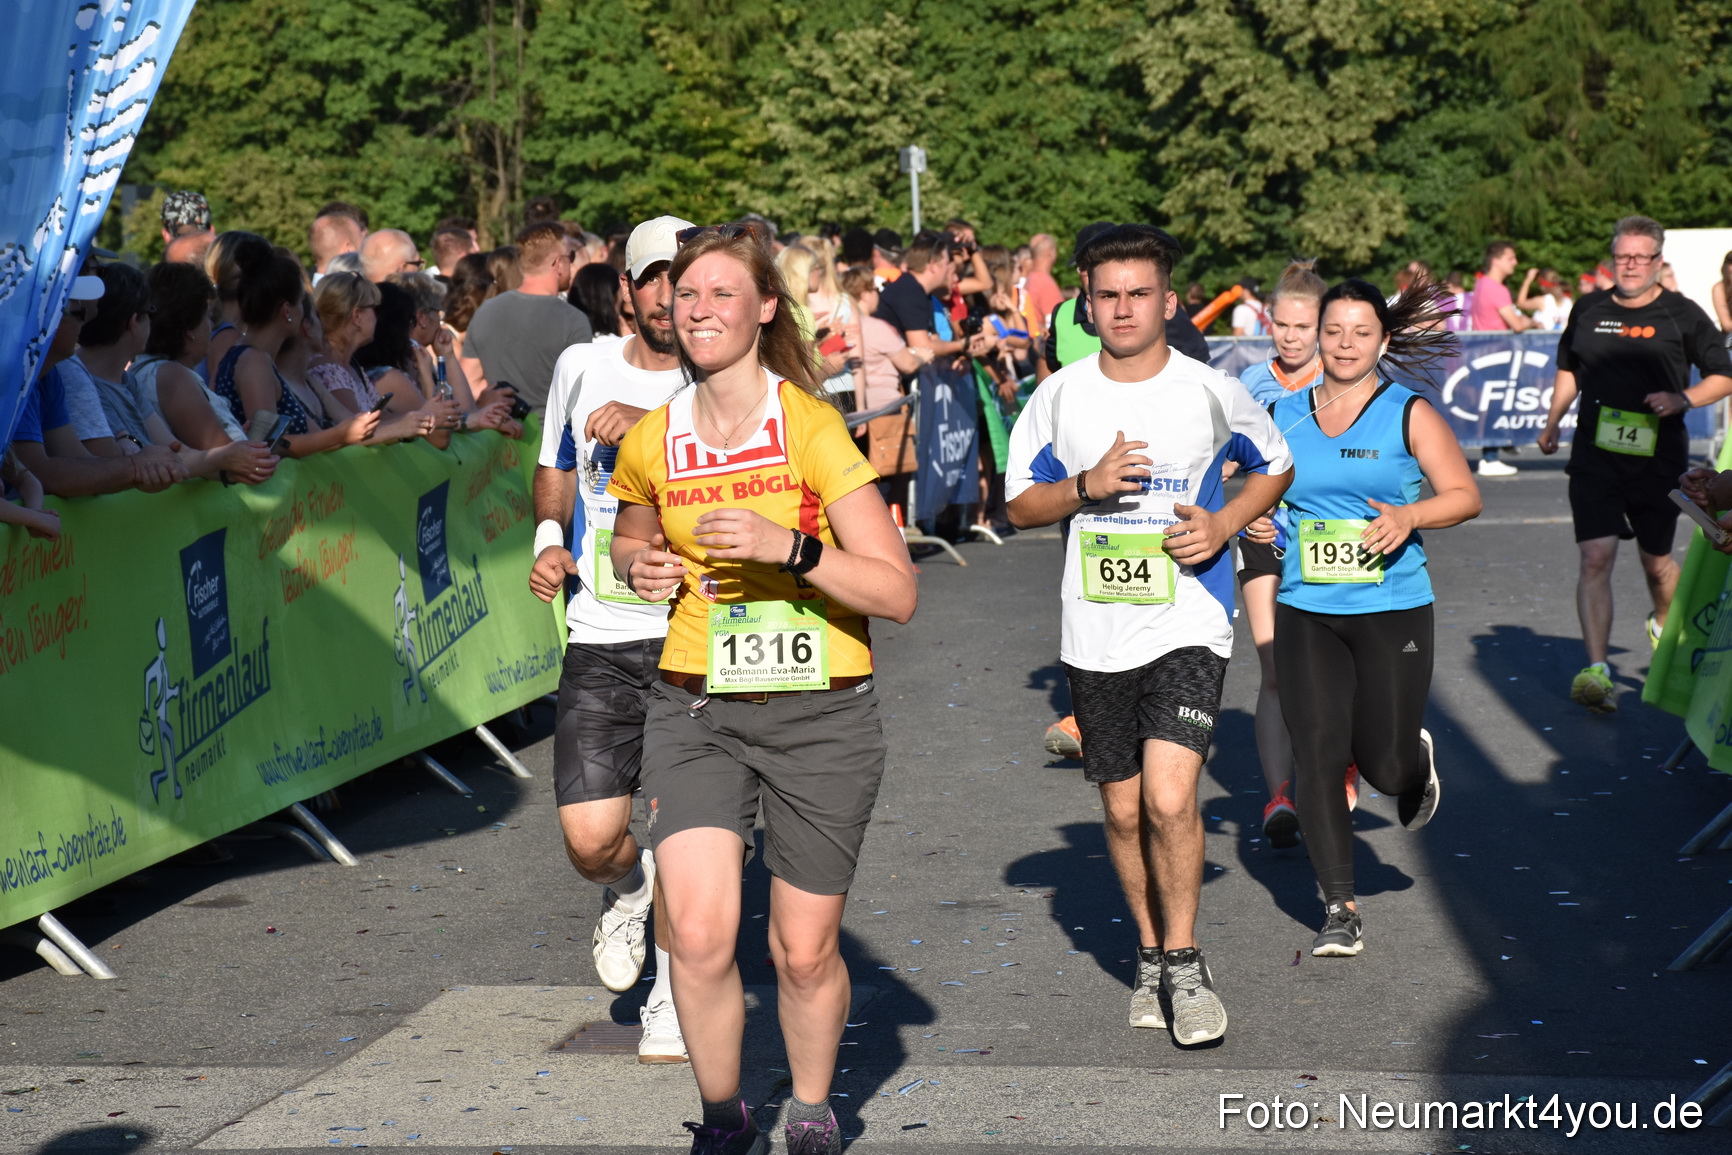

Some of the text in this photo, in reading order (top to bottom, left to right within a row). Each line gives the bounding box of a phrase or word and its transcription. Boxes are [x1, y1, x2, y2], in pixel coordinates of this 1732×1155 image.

[1617, 426, 1638, 442] 14
[1340, 449, 1379, 459] THULE
[666, 474, 800, 508] MAX BÖGL
[1100, 558, 1151, 584] 634
[193, 575, 219, 608] Fischer
[1102, 583, 1151, 592] Helbig Jeremy
[405, 553, 489, 664] firmenlauf
[722, 615, 762, 624] firmenlauf
[722, 632, 813, 666] 1316
[427, 648, 460, 689] neumarkt
[720, 666, 816, 677] Großmann Eva-Maria
[738, 676, 754, 684] Bögl
[754, 675, 790, 683] Bauservice
[179, 616, 271, 753] firmenlauf
[1178, 706, 1214, 727] BOSS
[185, 732, 227, 787] neumarkt
